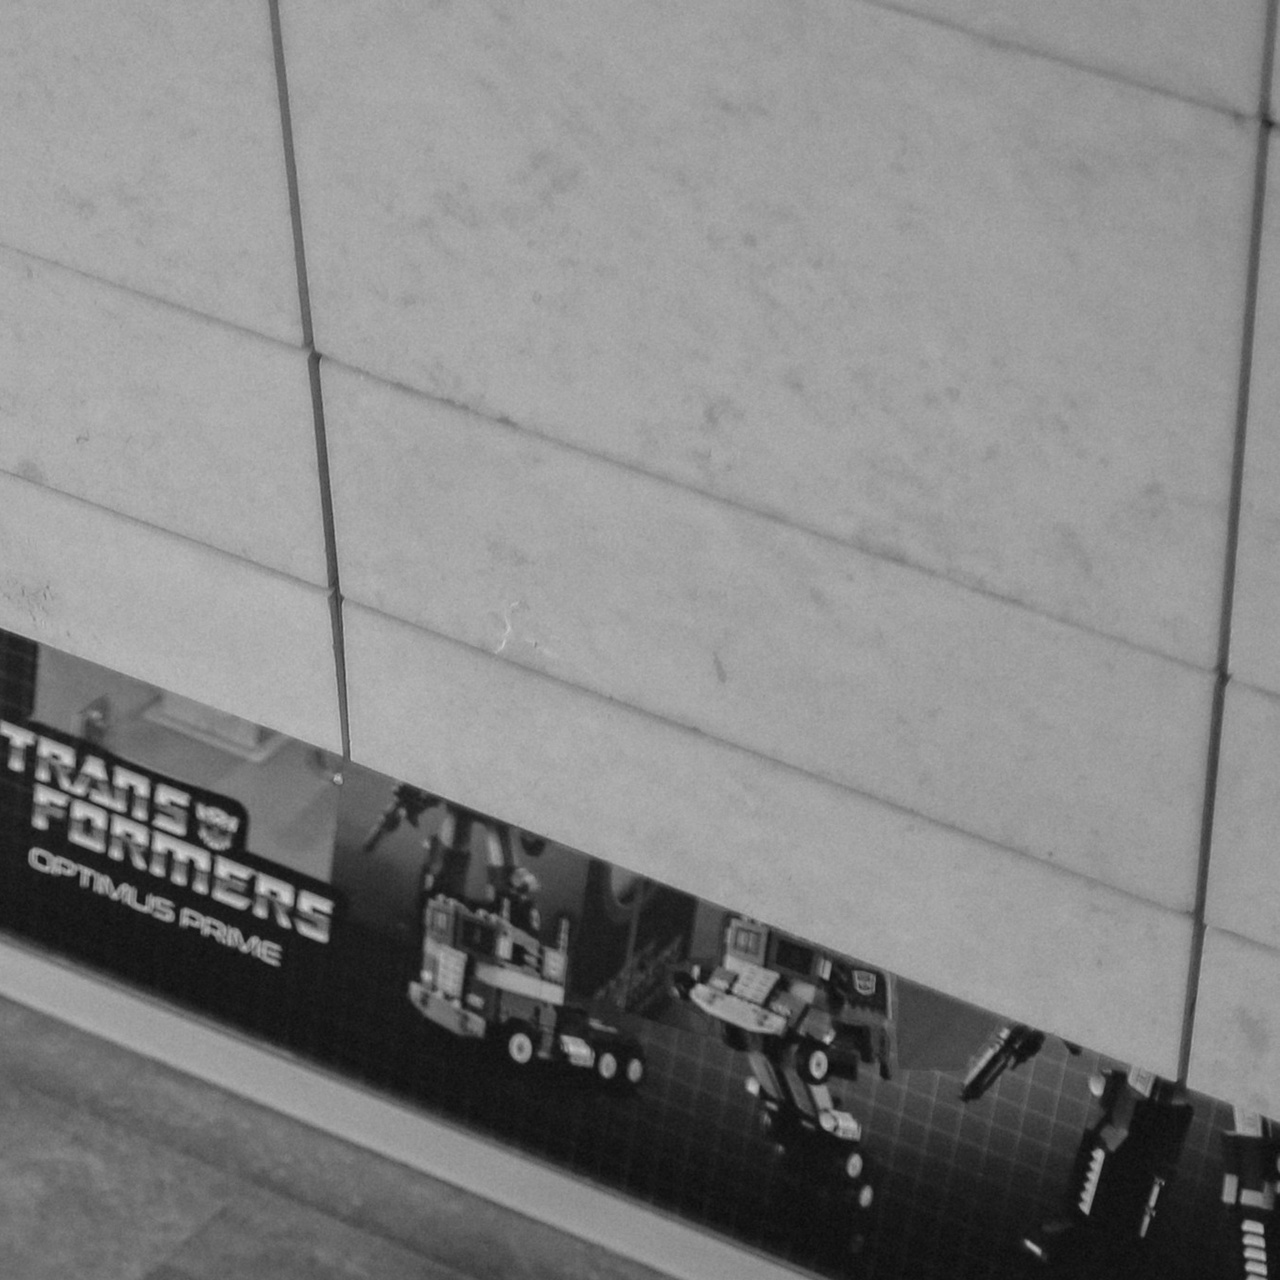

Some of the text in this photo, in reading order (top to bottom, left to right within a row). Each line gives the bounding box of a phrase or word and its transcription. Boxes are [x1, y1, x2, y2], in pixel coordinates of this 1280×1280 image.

[26, 845, 284, 969] OPTIMUS PRIME
[30, 781, 336, 945] FORMERS
